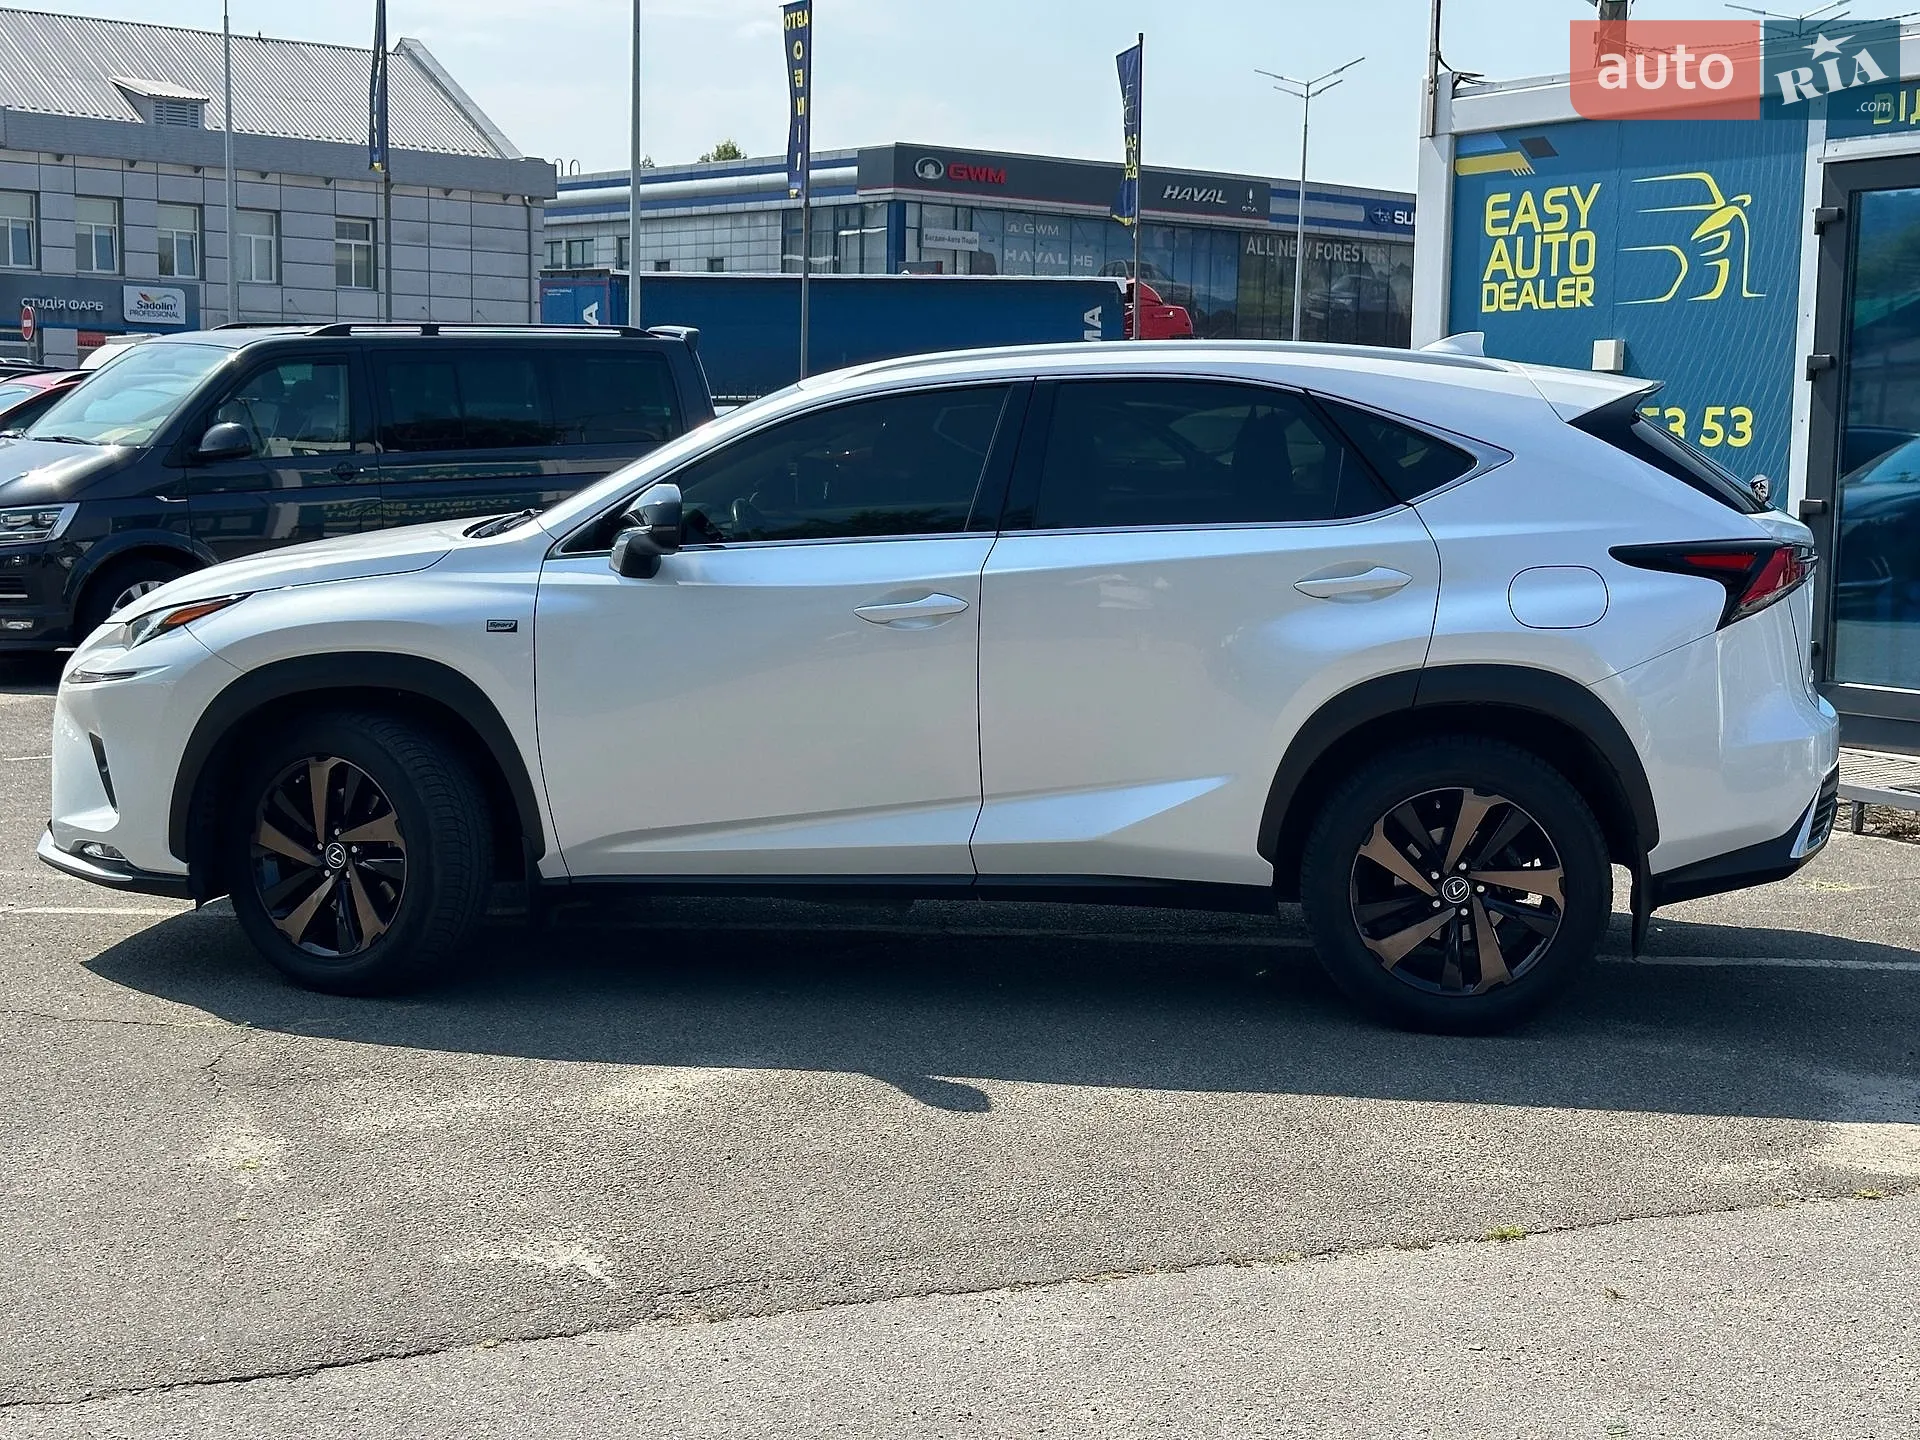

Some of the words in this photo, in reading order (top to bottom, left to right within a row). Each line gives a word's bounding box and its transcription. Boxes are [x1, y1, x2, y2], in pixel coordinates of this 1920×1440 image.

[949, 164, 1006, 183] GWM
[1162, 185, 1228, 204] HAVAL
[1484, 183, 1601, 237] EASY
[1023, 223, 1060, 236] GWM
[1005, 249, 1068, 266] HAVAL
[1246, 236, 1274, 256] ALL
[1315, 242, 1386, 264] FORESTER
[1482, 231, 1597, 282] AUTO
[20, 296, 66, 311] СТУДІЯ
[68, 298, 104, 312] ФАРБ
[1481, 276, 1595, 313] DEALER
[129, 309, 180, 319] PROFESSIONAL
[136, 300, 175, 311] Sadolin
[1699, 406, 1754, 447] 53
